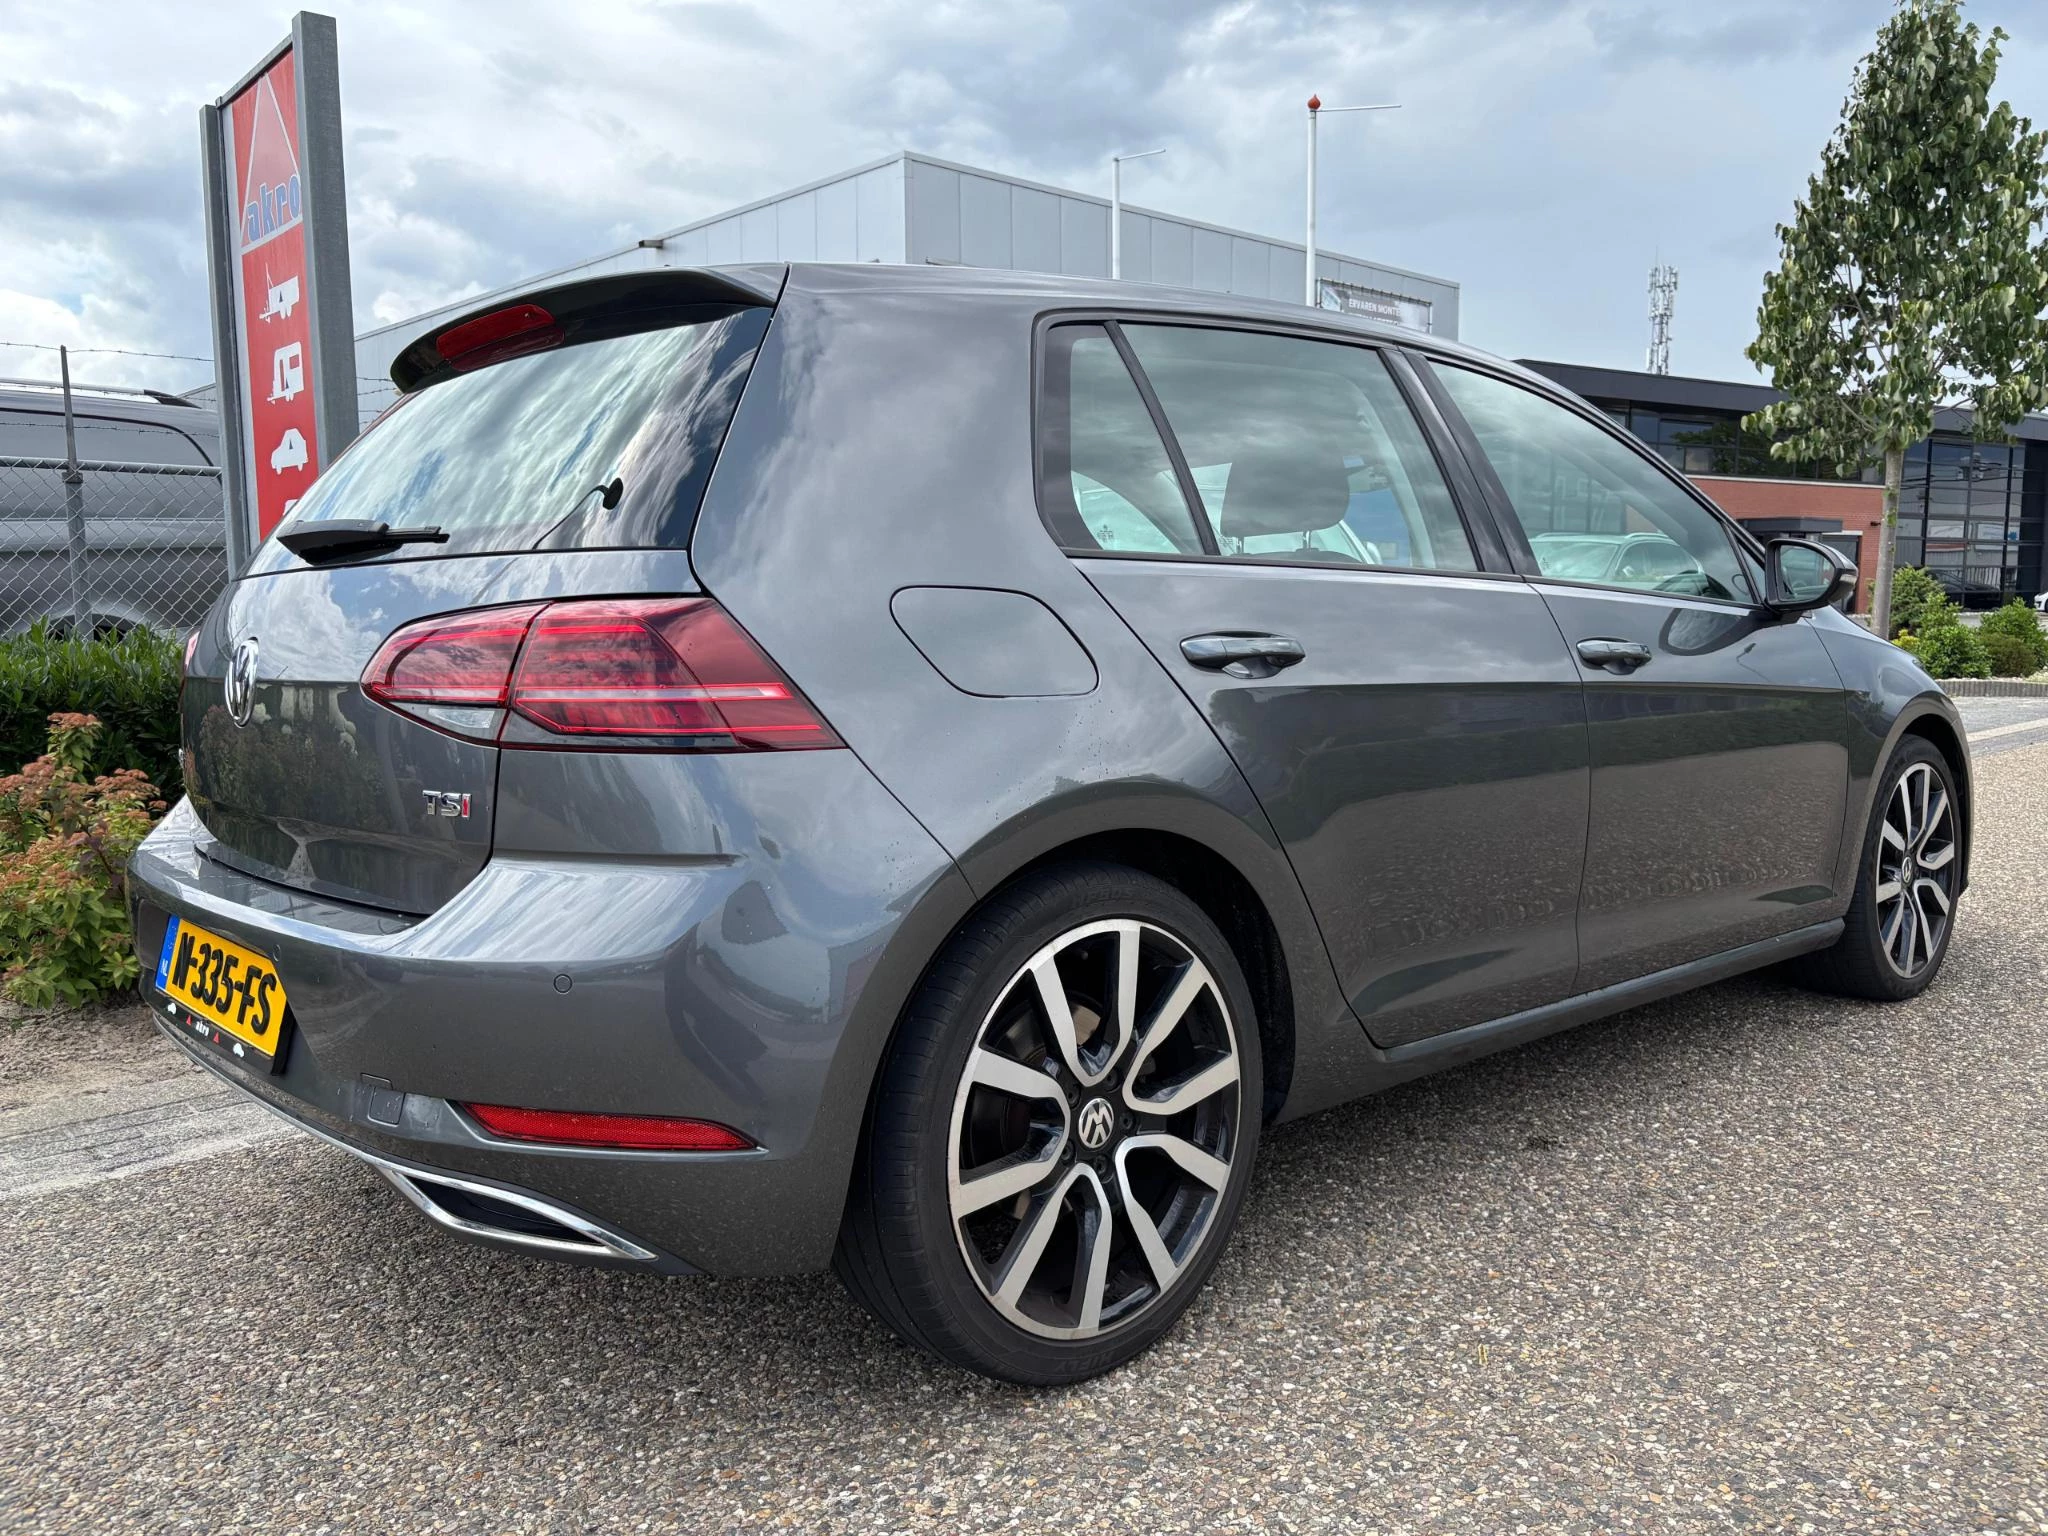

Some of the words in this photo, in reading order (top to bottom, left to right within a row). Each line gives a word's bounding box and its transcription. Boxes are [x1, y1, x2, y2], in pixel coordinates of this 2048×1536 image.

[246, 174, 301, 241] akro
[421, 790, 472, 818] TSI
[171, 932, 277, 1035] N-335-FS
